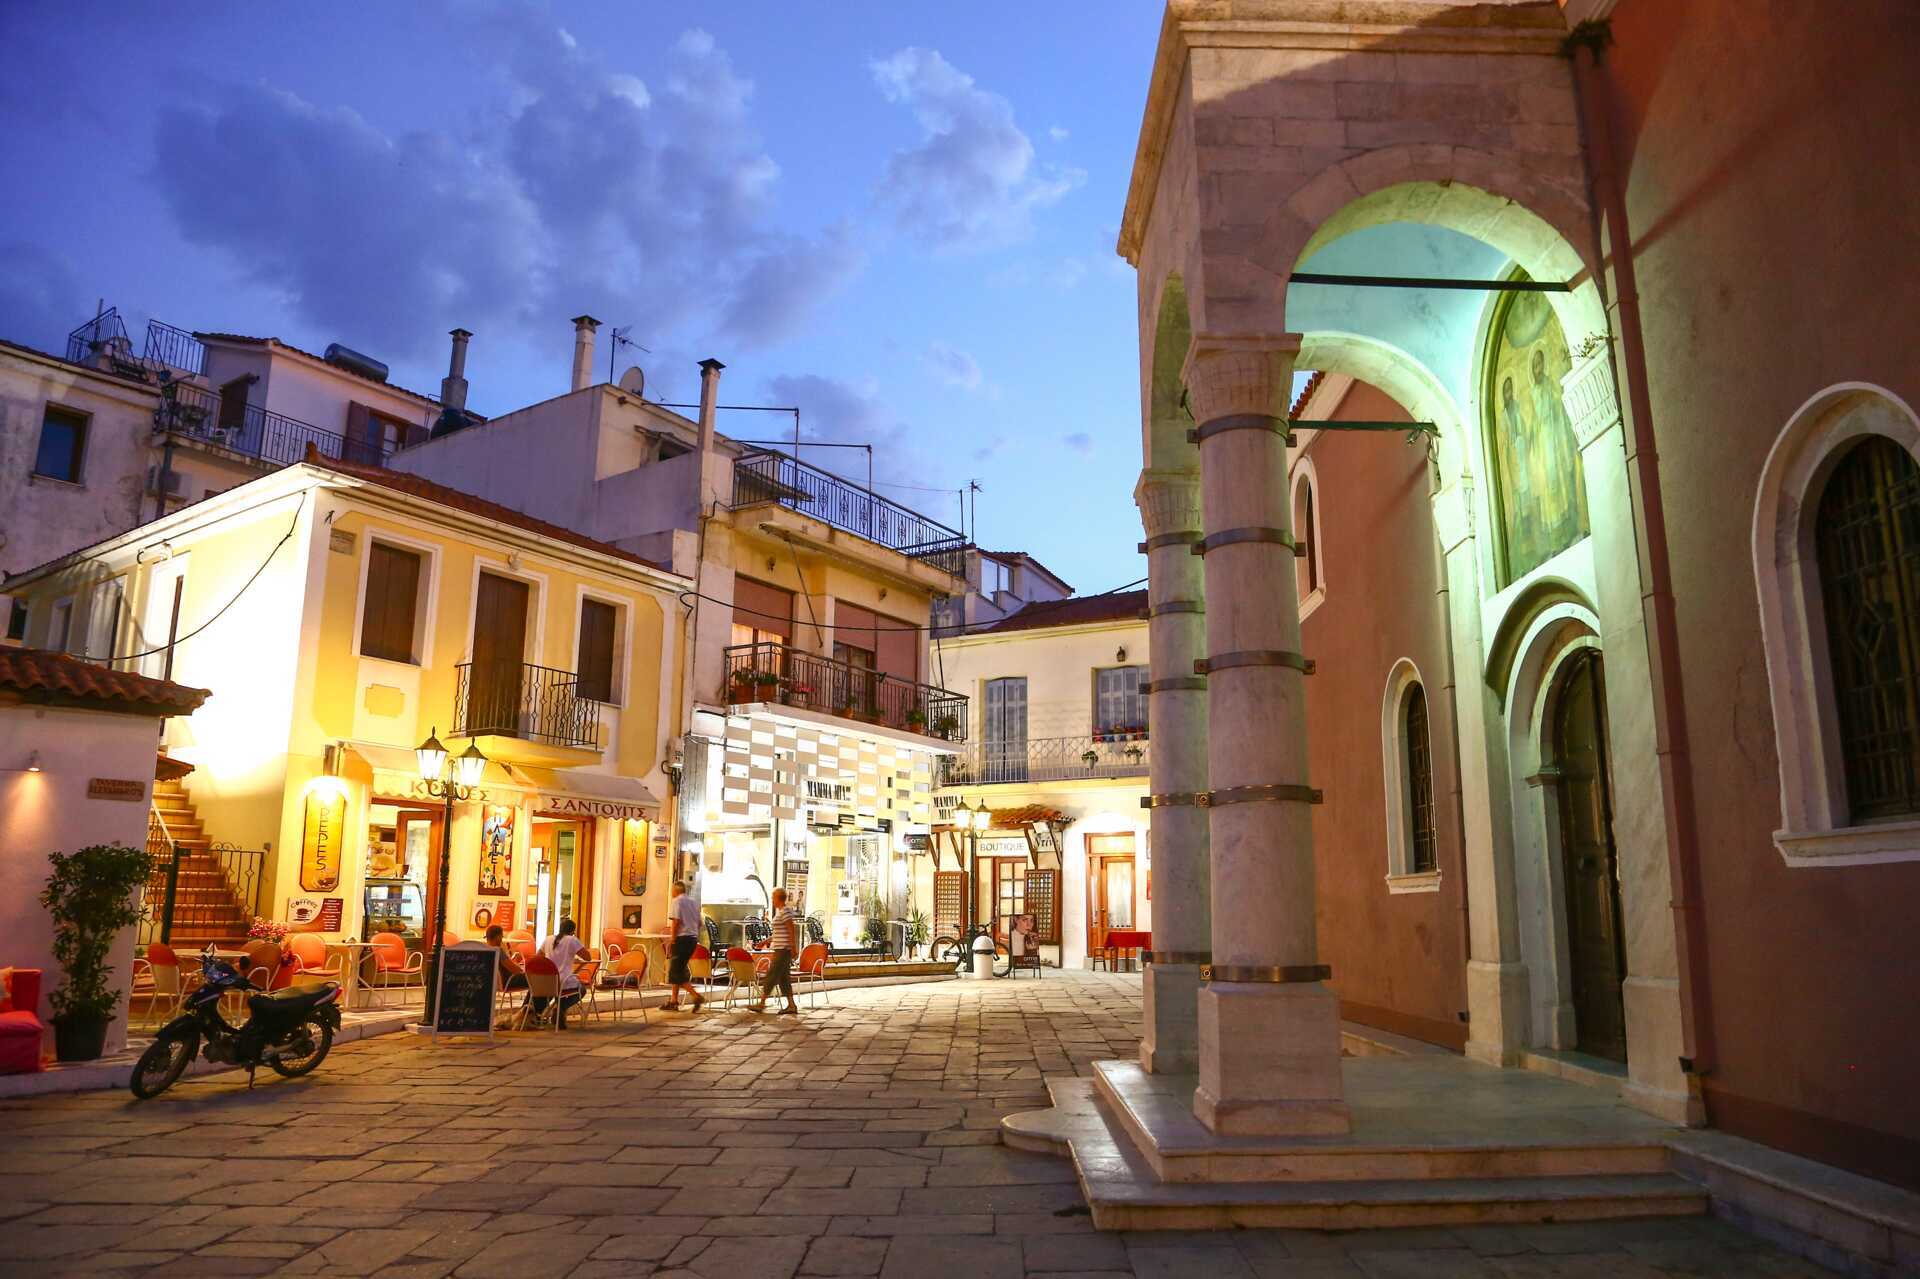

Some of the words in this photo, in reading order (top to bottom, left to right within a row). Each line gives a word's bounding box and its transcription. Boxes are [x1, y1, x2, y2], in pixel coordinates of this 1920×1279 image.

[807, 781, 832, 799] MAMMA
[834, 784, 846, 800] MIA
[551, 798, 647, 818] ΣΑΝΤΟΥΙΤΣ
[933, 796, 958, 807] MAMMA
[980, 842, 1025, 851] BOUTIQUE
